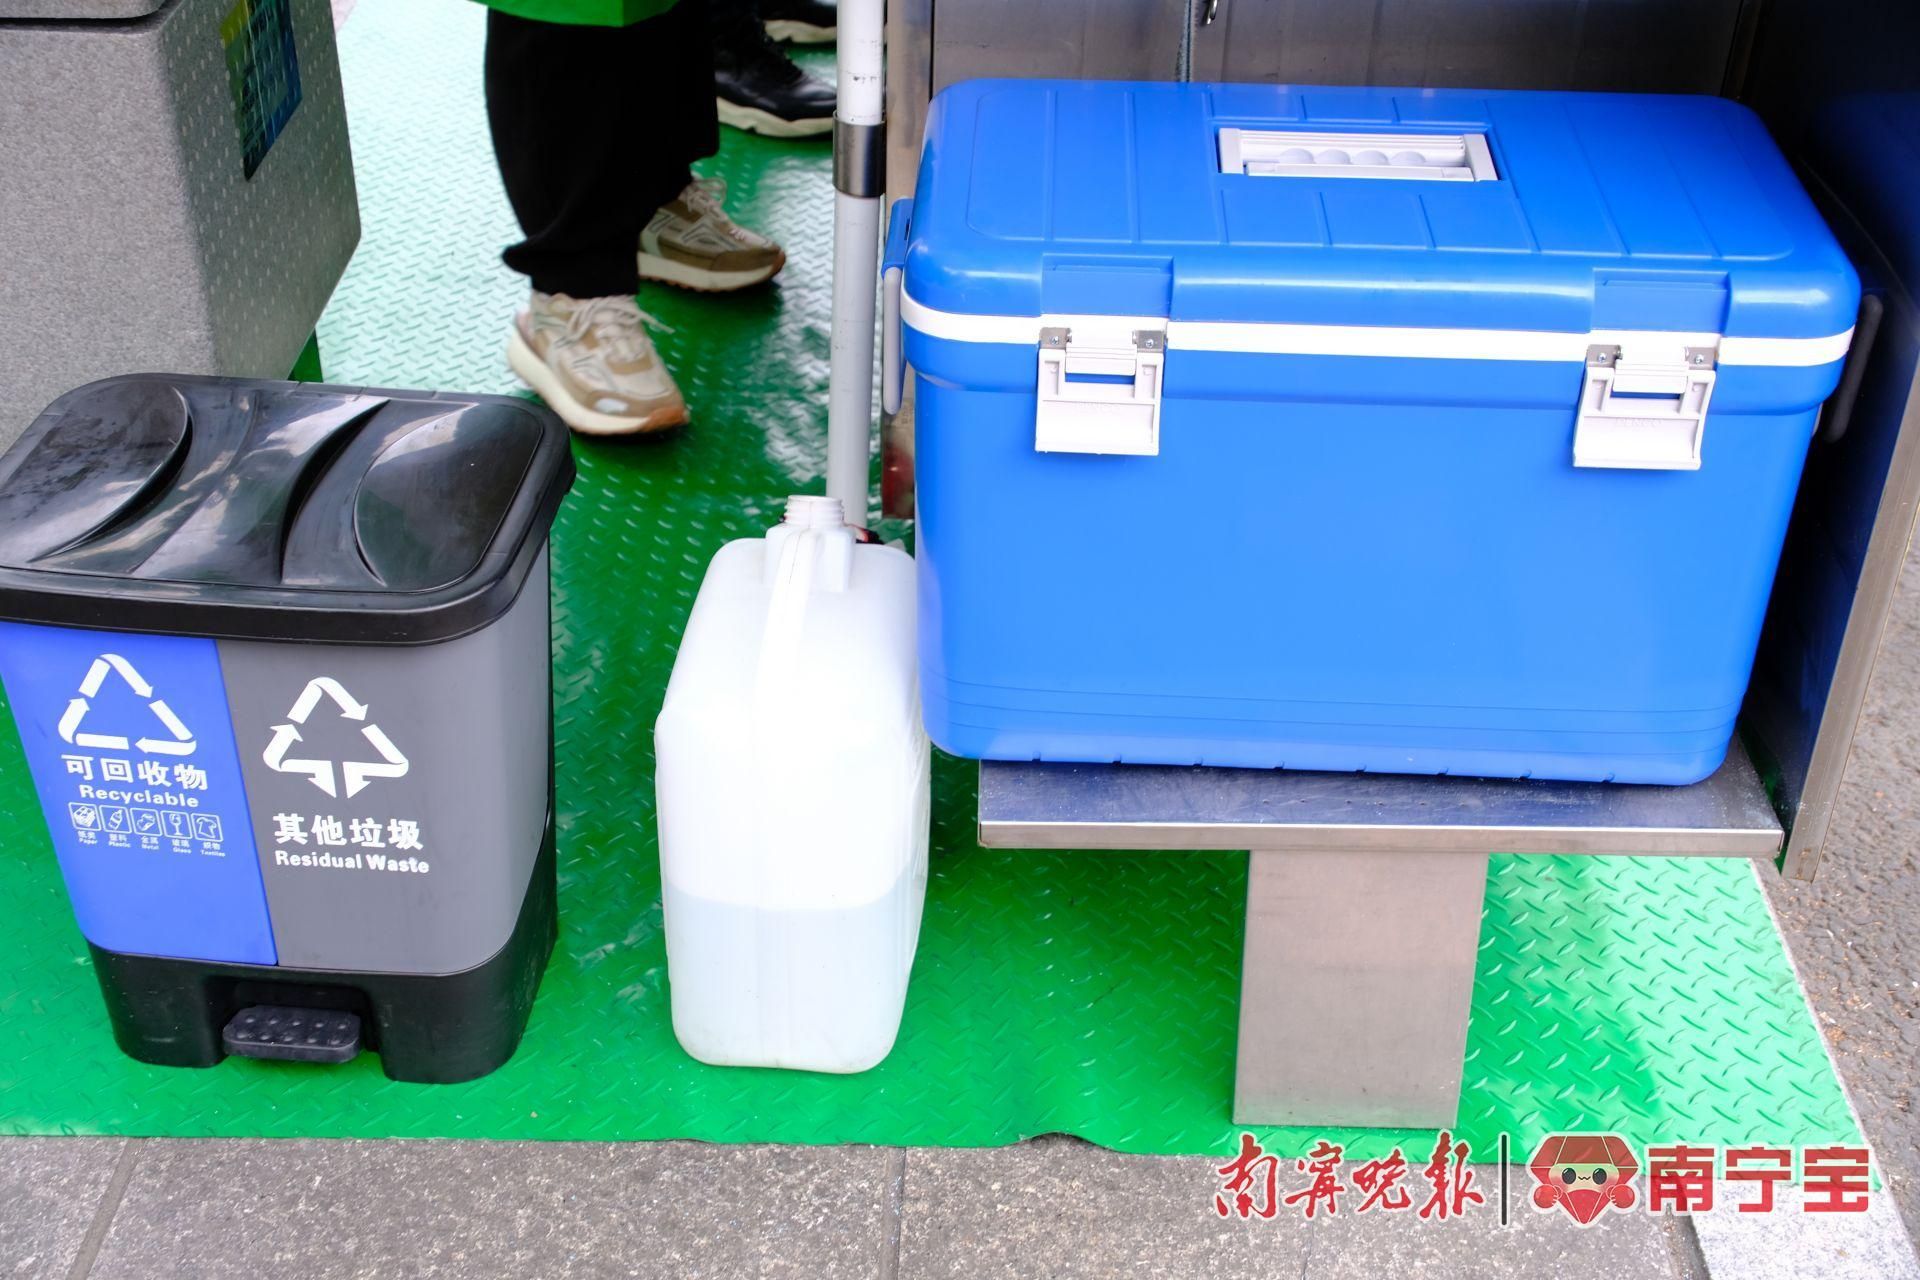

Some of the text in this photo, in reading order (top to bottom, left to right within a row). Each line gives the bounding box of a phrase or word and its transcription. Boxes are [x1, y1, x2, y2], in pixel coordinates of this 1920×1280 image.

[61, 754, 208, 790] 可回收物
[79, 784, 199, 807] Recyclable
[273, 812, 424, 850] 其他垃圾
[275, 850, 429, 873] Residual Waste
